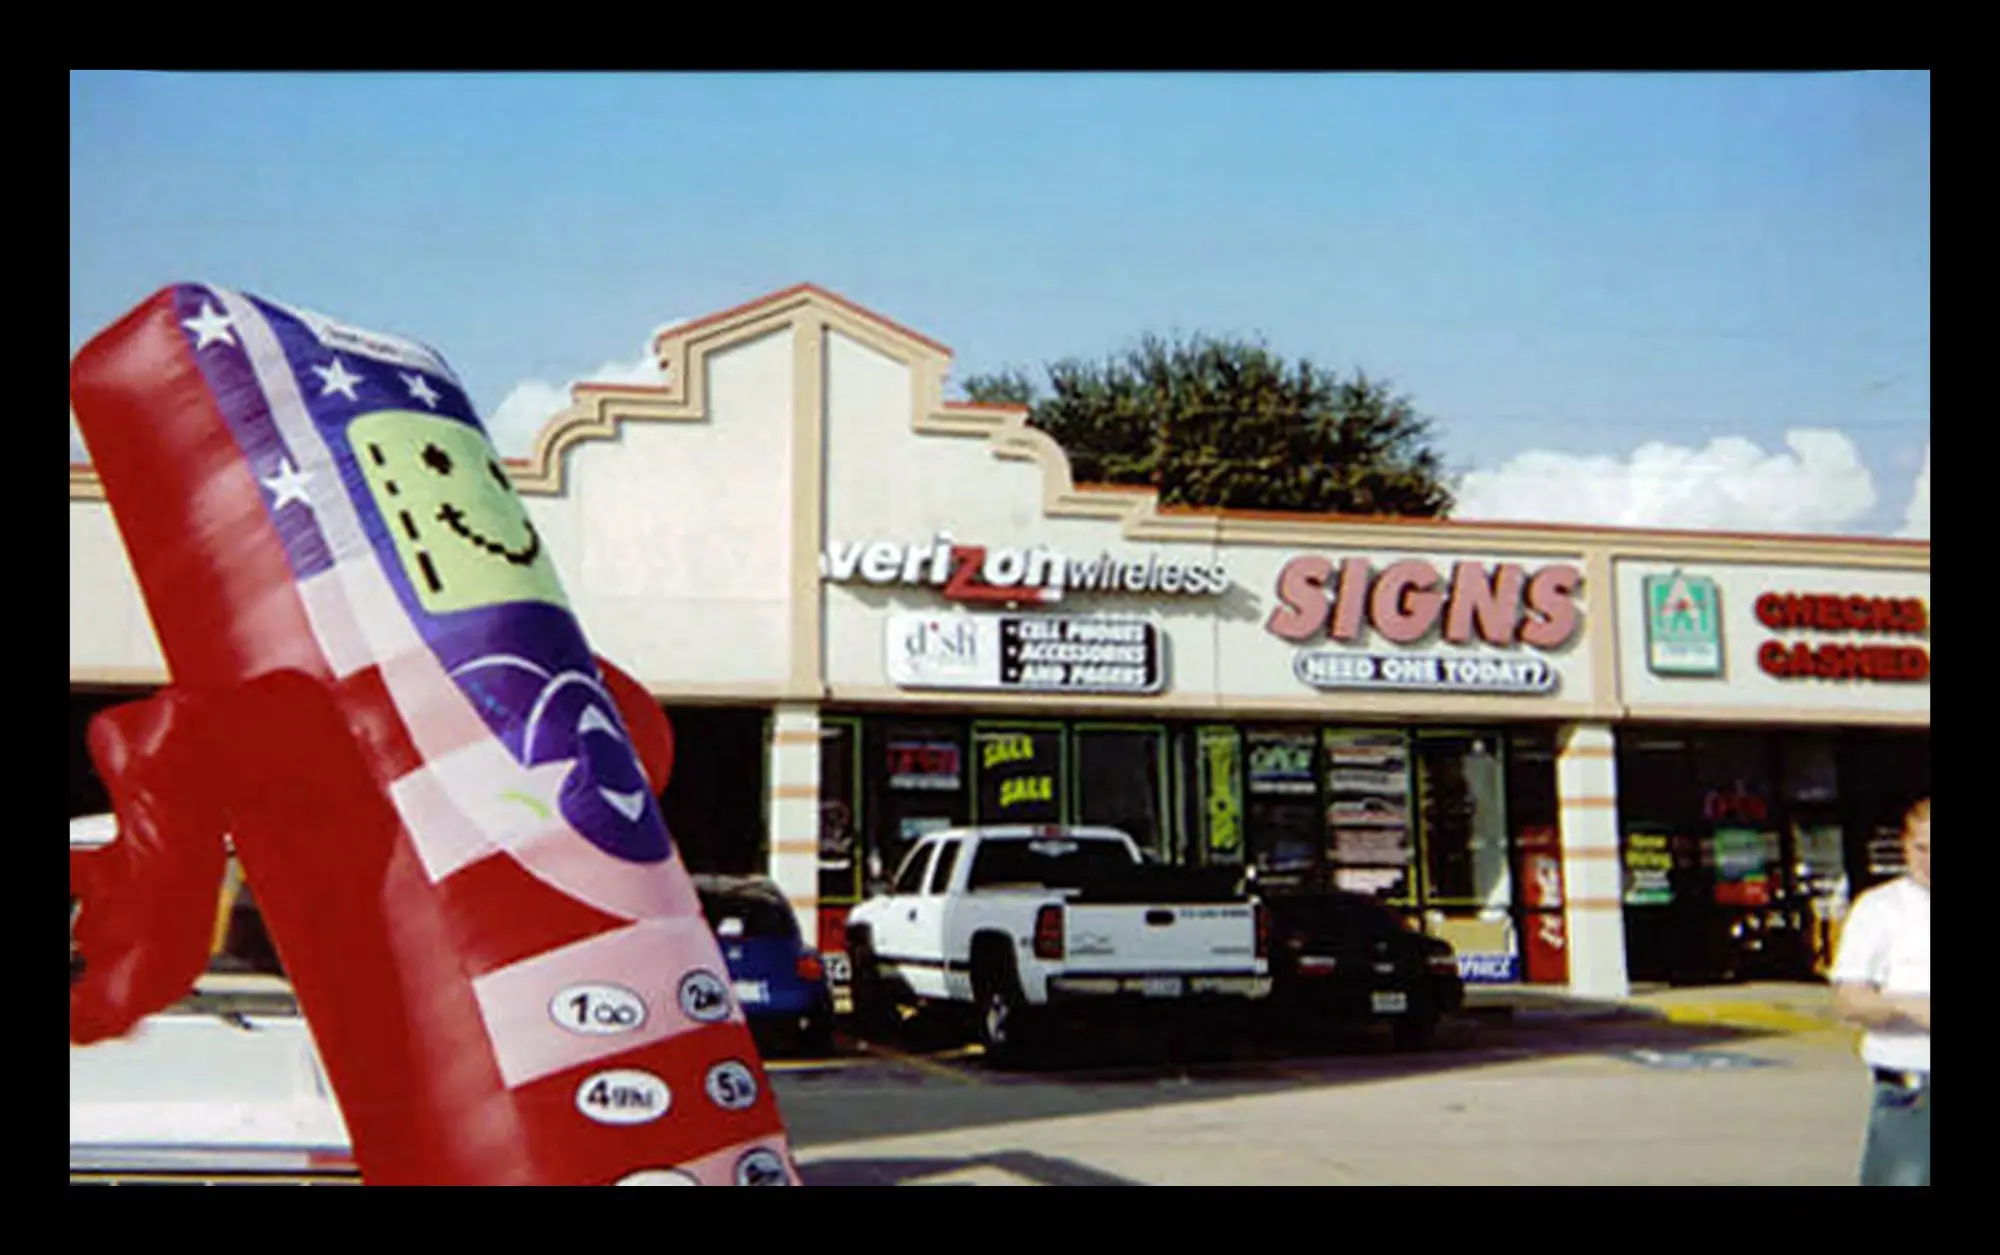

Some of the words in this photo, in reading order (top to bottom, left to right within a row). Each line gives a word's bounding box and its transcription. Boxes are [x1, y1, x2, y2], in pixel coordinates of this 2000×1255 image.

[1265, 555, 1584, 648] SIGNS
[1755, 592, 1929, 632] CHECKS
[1018, 619, 1062, 641] CELL
[1066, 621, 1146, 644] PHONES
[1018, 644, 1147, 664] ACCESSORIES
[1757, 640, 1930, 682] CASHED
[1018, 666, 1064, 684] AND
[1068, 667, 1147, 687] PAGERS
[1306, 655, 1375, 681] NEED
[1382, 657, 1438, 684] ONE
[1445, 659, 1542, 685] TODAY?
[1001, 775, 1053, 808] SALE
